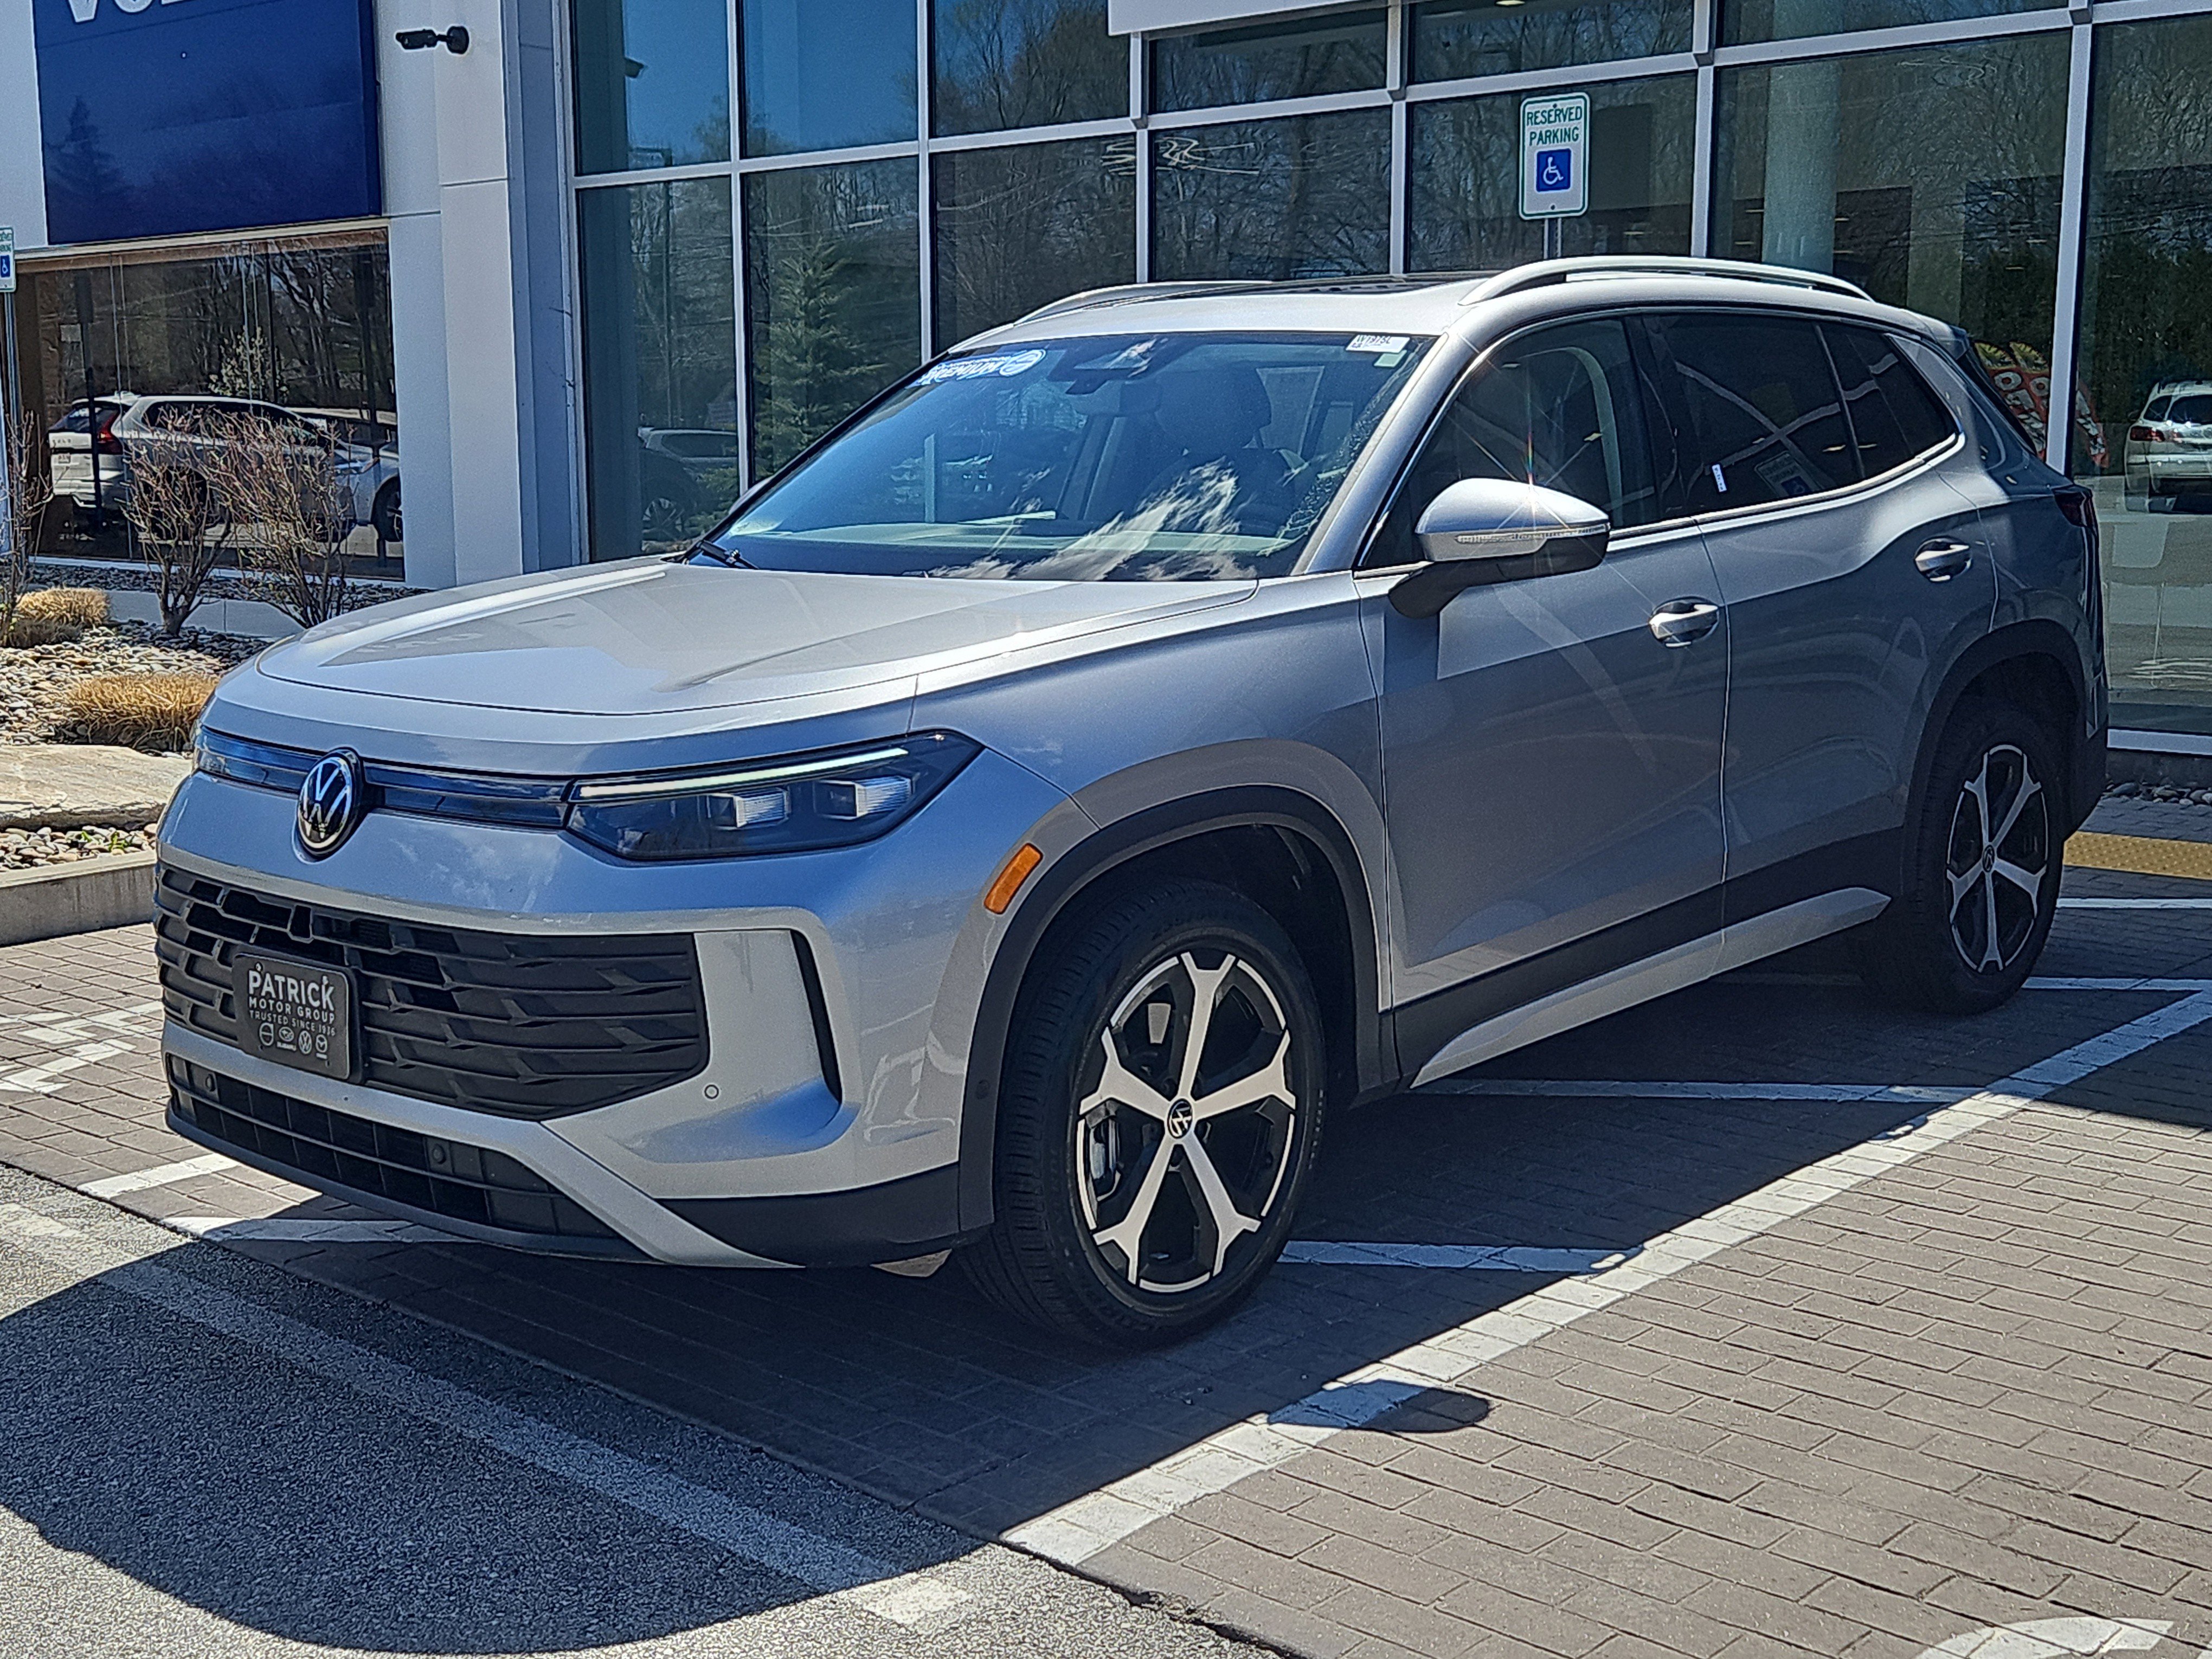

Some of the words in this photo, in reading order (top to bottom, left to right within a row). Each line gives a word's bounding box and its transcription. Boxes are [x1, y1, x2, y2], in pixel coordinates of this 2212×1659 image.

[1527, 106, 1582, 126] RESERVED
[1529, 127, 1579, 145] PARKING
[249, 970, 335, 1011] PATRICK
[249, 996, 292, 1015] MOTOR
[297, 1006, 335, 1024] GROUP
[249, 1011, 289, 1025] TRUSTED
[291, 1018, 316, 1032] SINCE
